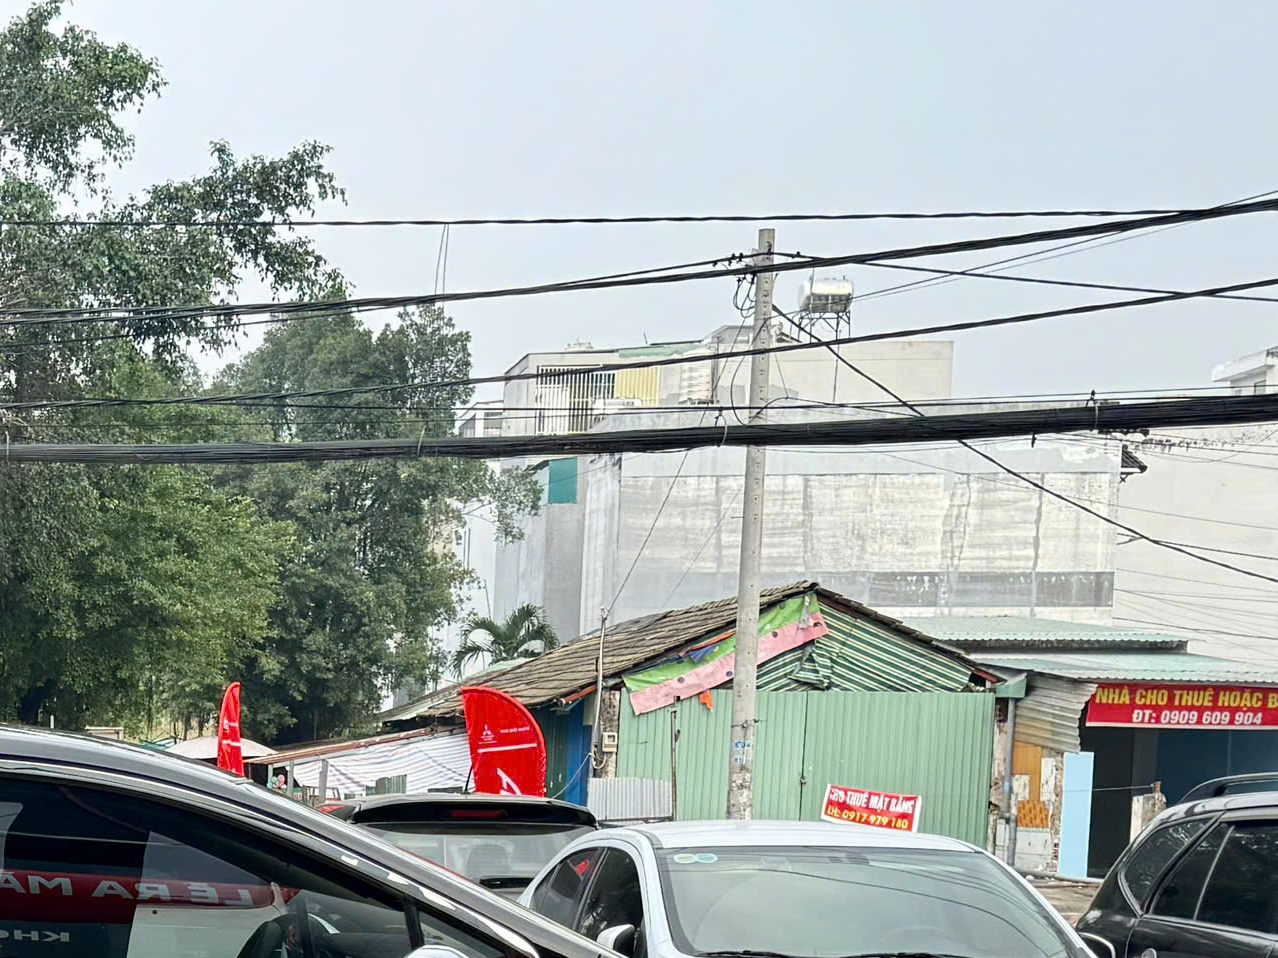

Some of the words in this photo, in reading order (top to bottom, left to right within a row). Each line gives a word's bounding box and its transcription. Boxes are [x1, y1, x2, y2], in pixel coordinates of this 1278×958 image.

[1095, 685, 1130, 705] NHÀ
[1135, 689, 1168, 706] CHO
[1174, 688, 1213, 707] THUÊ
[1218, 688, 1263, 711] HOẶC
[1132, 709, 1156, 723] ĐT:
[1160, 710, 1198, 724] 0909
[1202, 711, 1231, 724] 609
[1234, 712, 1263, 725] 904
[842, 809, 867, 823] 0917
